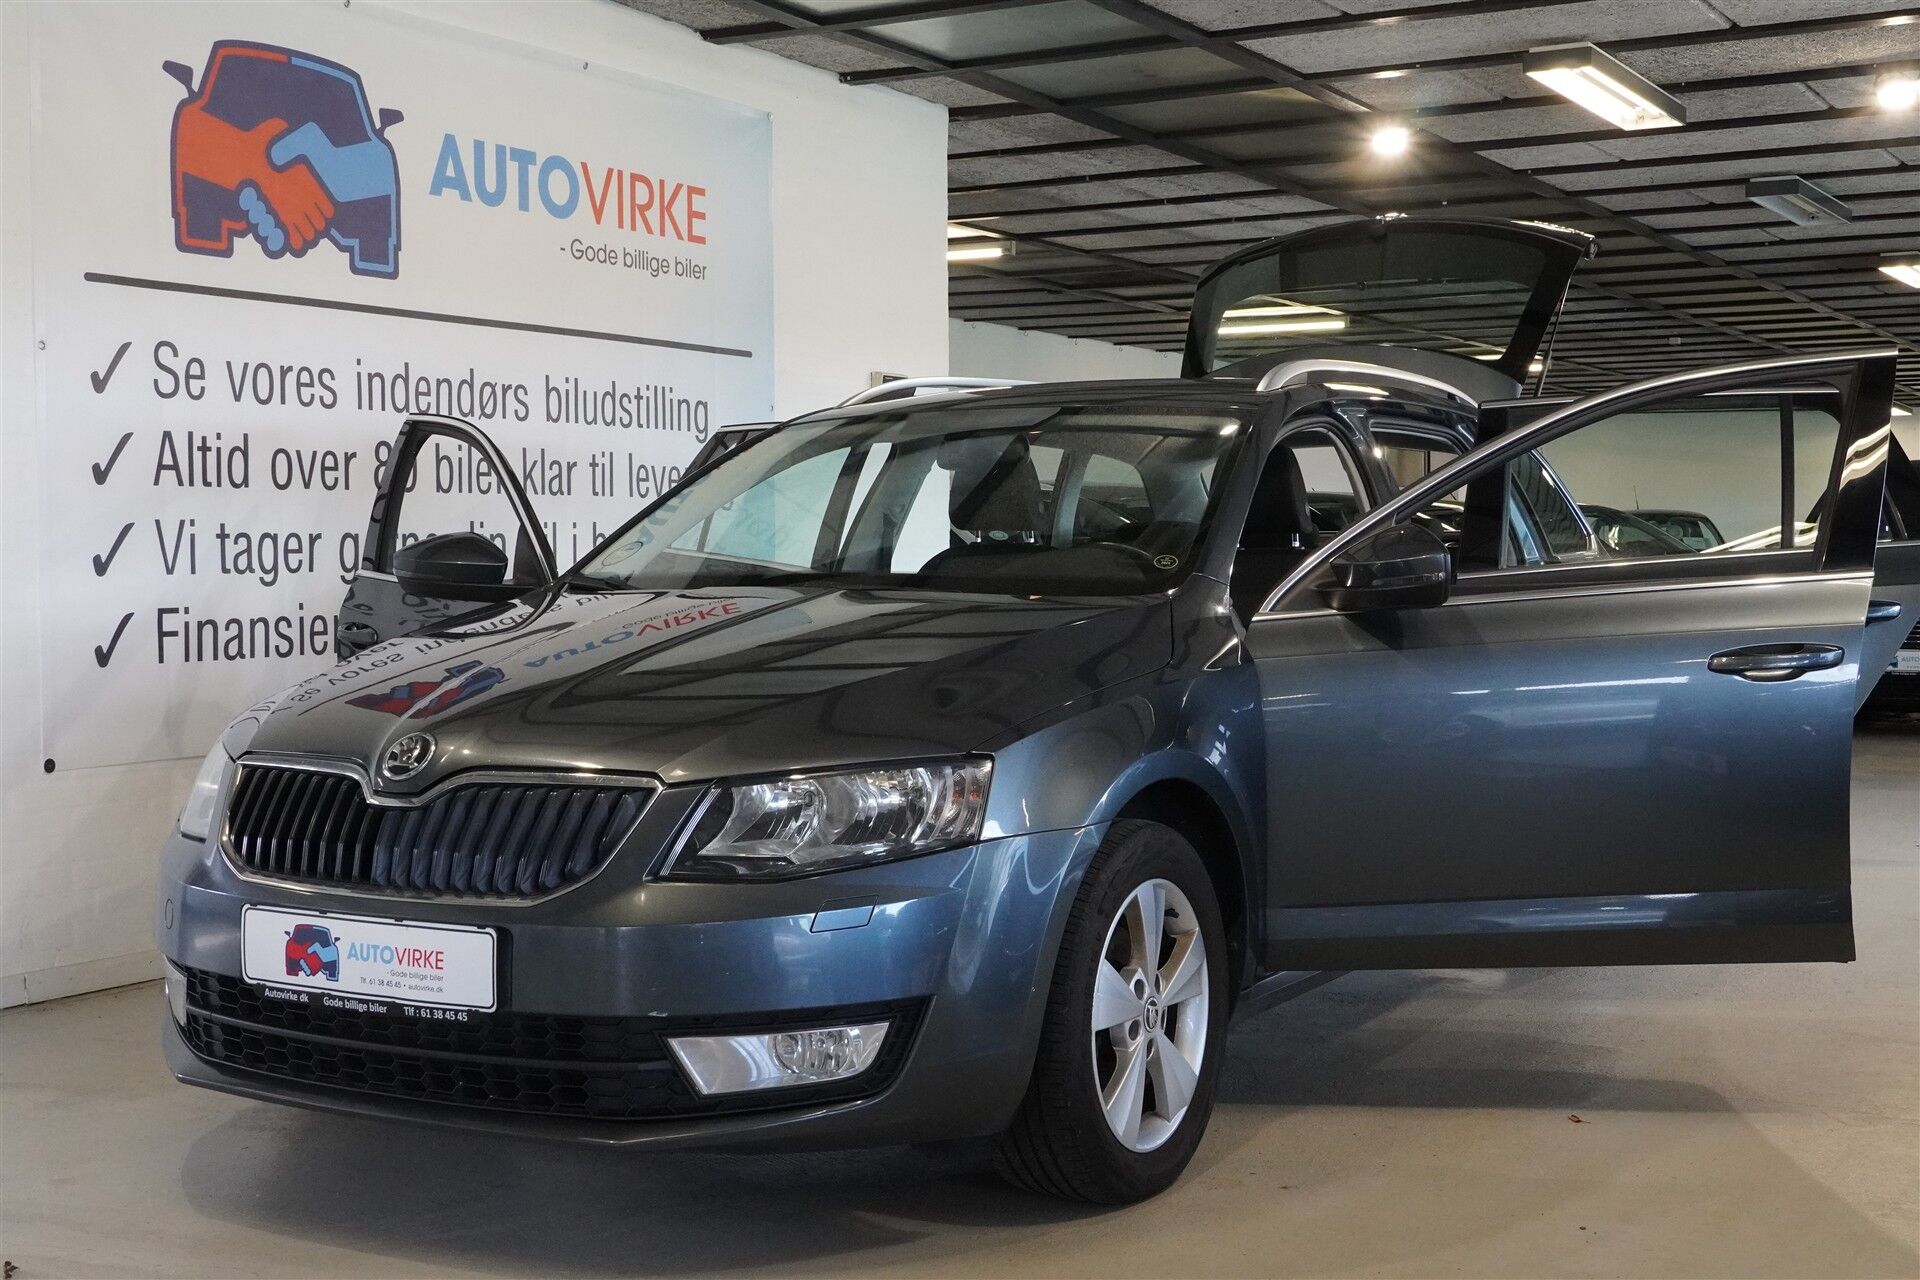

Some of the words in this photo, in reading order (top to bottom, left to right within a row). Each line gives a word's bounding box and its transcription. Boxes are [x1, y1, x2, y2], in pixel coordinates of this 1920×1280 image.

[429, 133, 706, 245] AUTOVIRKE
[570, 238, 618, 265] Gode
[623, 247, 670, 277] billige
[674, 256, 707, 280] biler
[153, 340, 206, 401] Se
[226, 360, 338, 409] vores
[356, 358, 530, 422] indendørs
[545, 374, 709, 443] biludstilling
[153, 430, 249, 489] Altid
[271, 447, 357, 491] over
[522, 447, 577, 496] klar
[589, 451, 613, 498] til
[155, 519, 196, 575] Vi
[216, 522, 322, 587] tager
[347, 942, 444, 970] AUTOVIRKE
[390, 969, 408, 978] Gode
[323, 996, 344, 1007] Gode
[345, 999, 368, 1013] billige
[369, 1003, 388, 1013] biler
[421, 1008, 431, 1018] 61
[433, 1009, 443, 1019] 38
[445, 1010, 456, 1020] 45
[457, 1012, 468, 1022] 45
